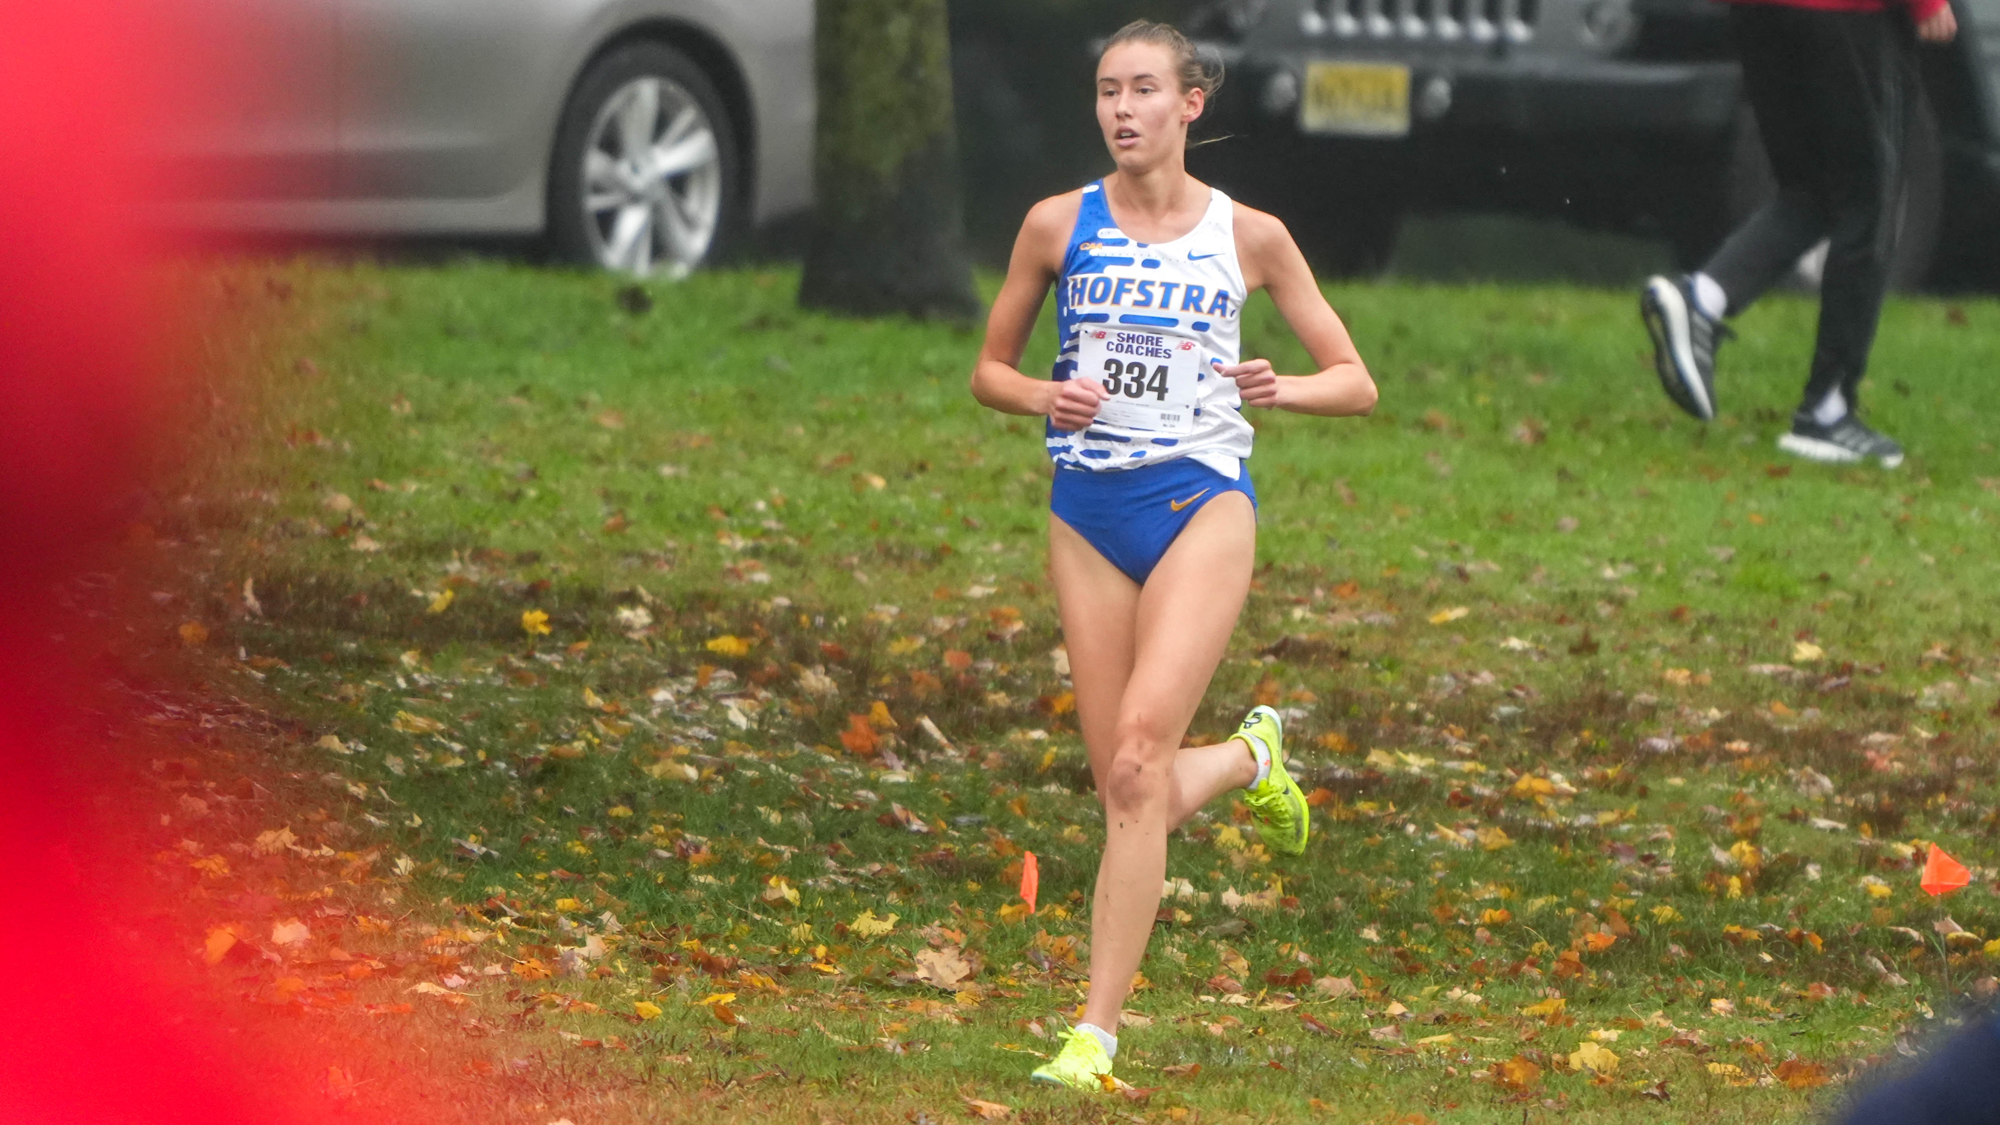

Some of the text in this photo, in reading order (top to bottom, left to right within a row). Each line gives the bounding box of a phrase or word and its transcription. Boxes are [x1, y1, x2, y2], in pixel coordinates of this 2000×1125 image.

[1070, 276, 1230, 318] HOFSTRA
[1106, 341, 1172, 359] COACHES
[1117, 332, 1163, 347] SHORE
[1102, 358, 1169, 401] 334
